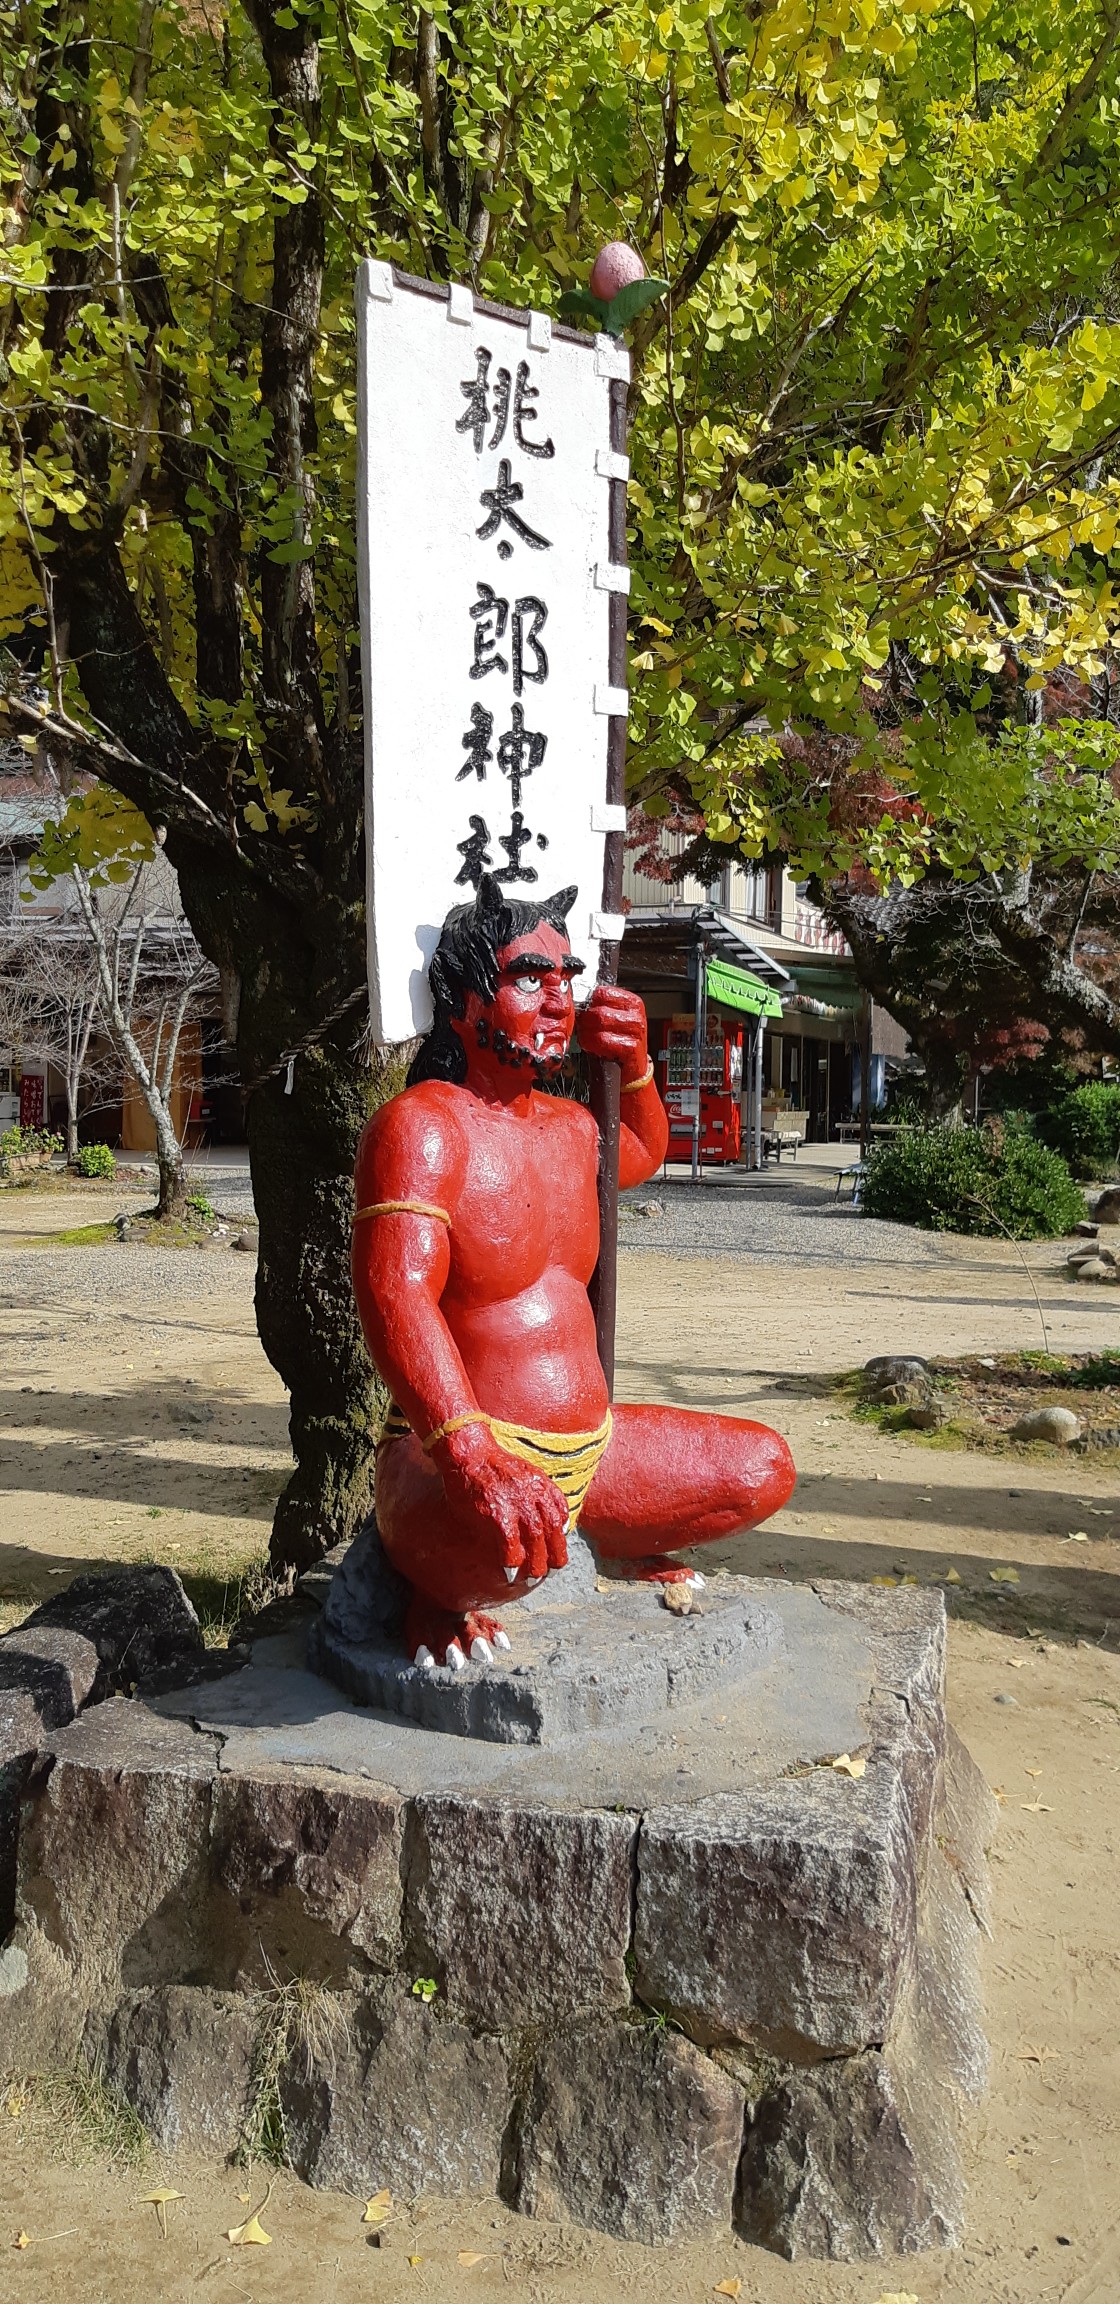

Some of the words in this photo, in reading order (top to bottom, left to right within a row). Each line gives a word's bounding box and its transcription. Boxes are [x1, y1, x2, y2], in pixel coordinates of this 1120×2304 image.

[454, 345, 556, 890] 桃太郎神社
